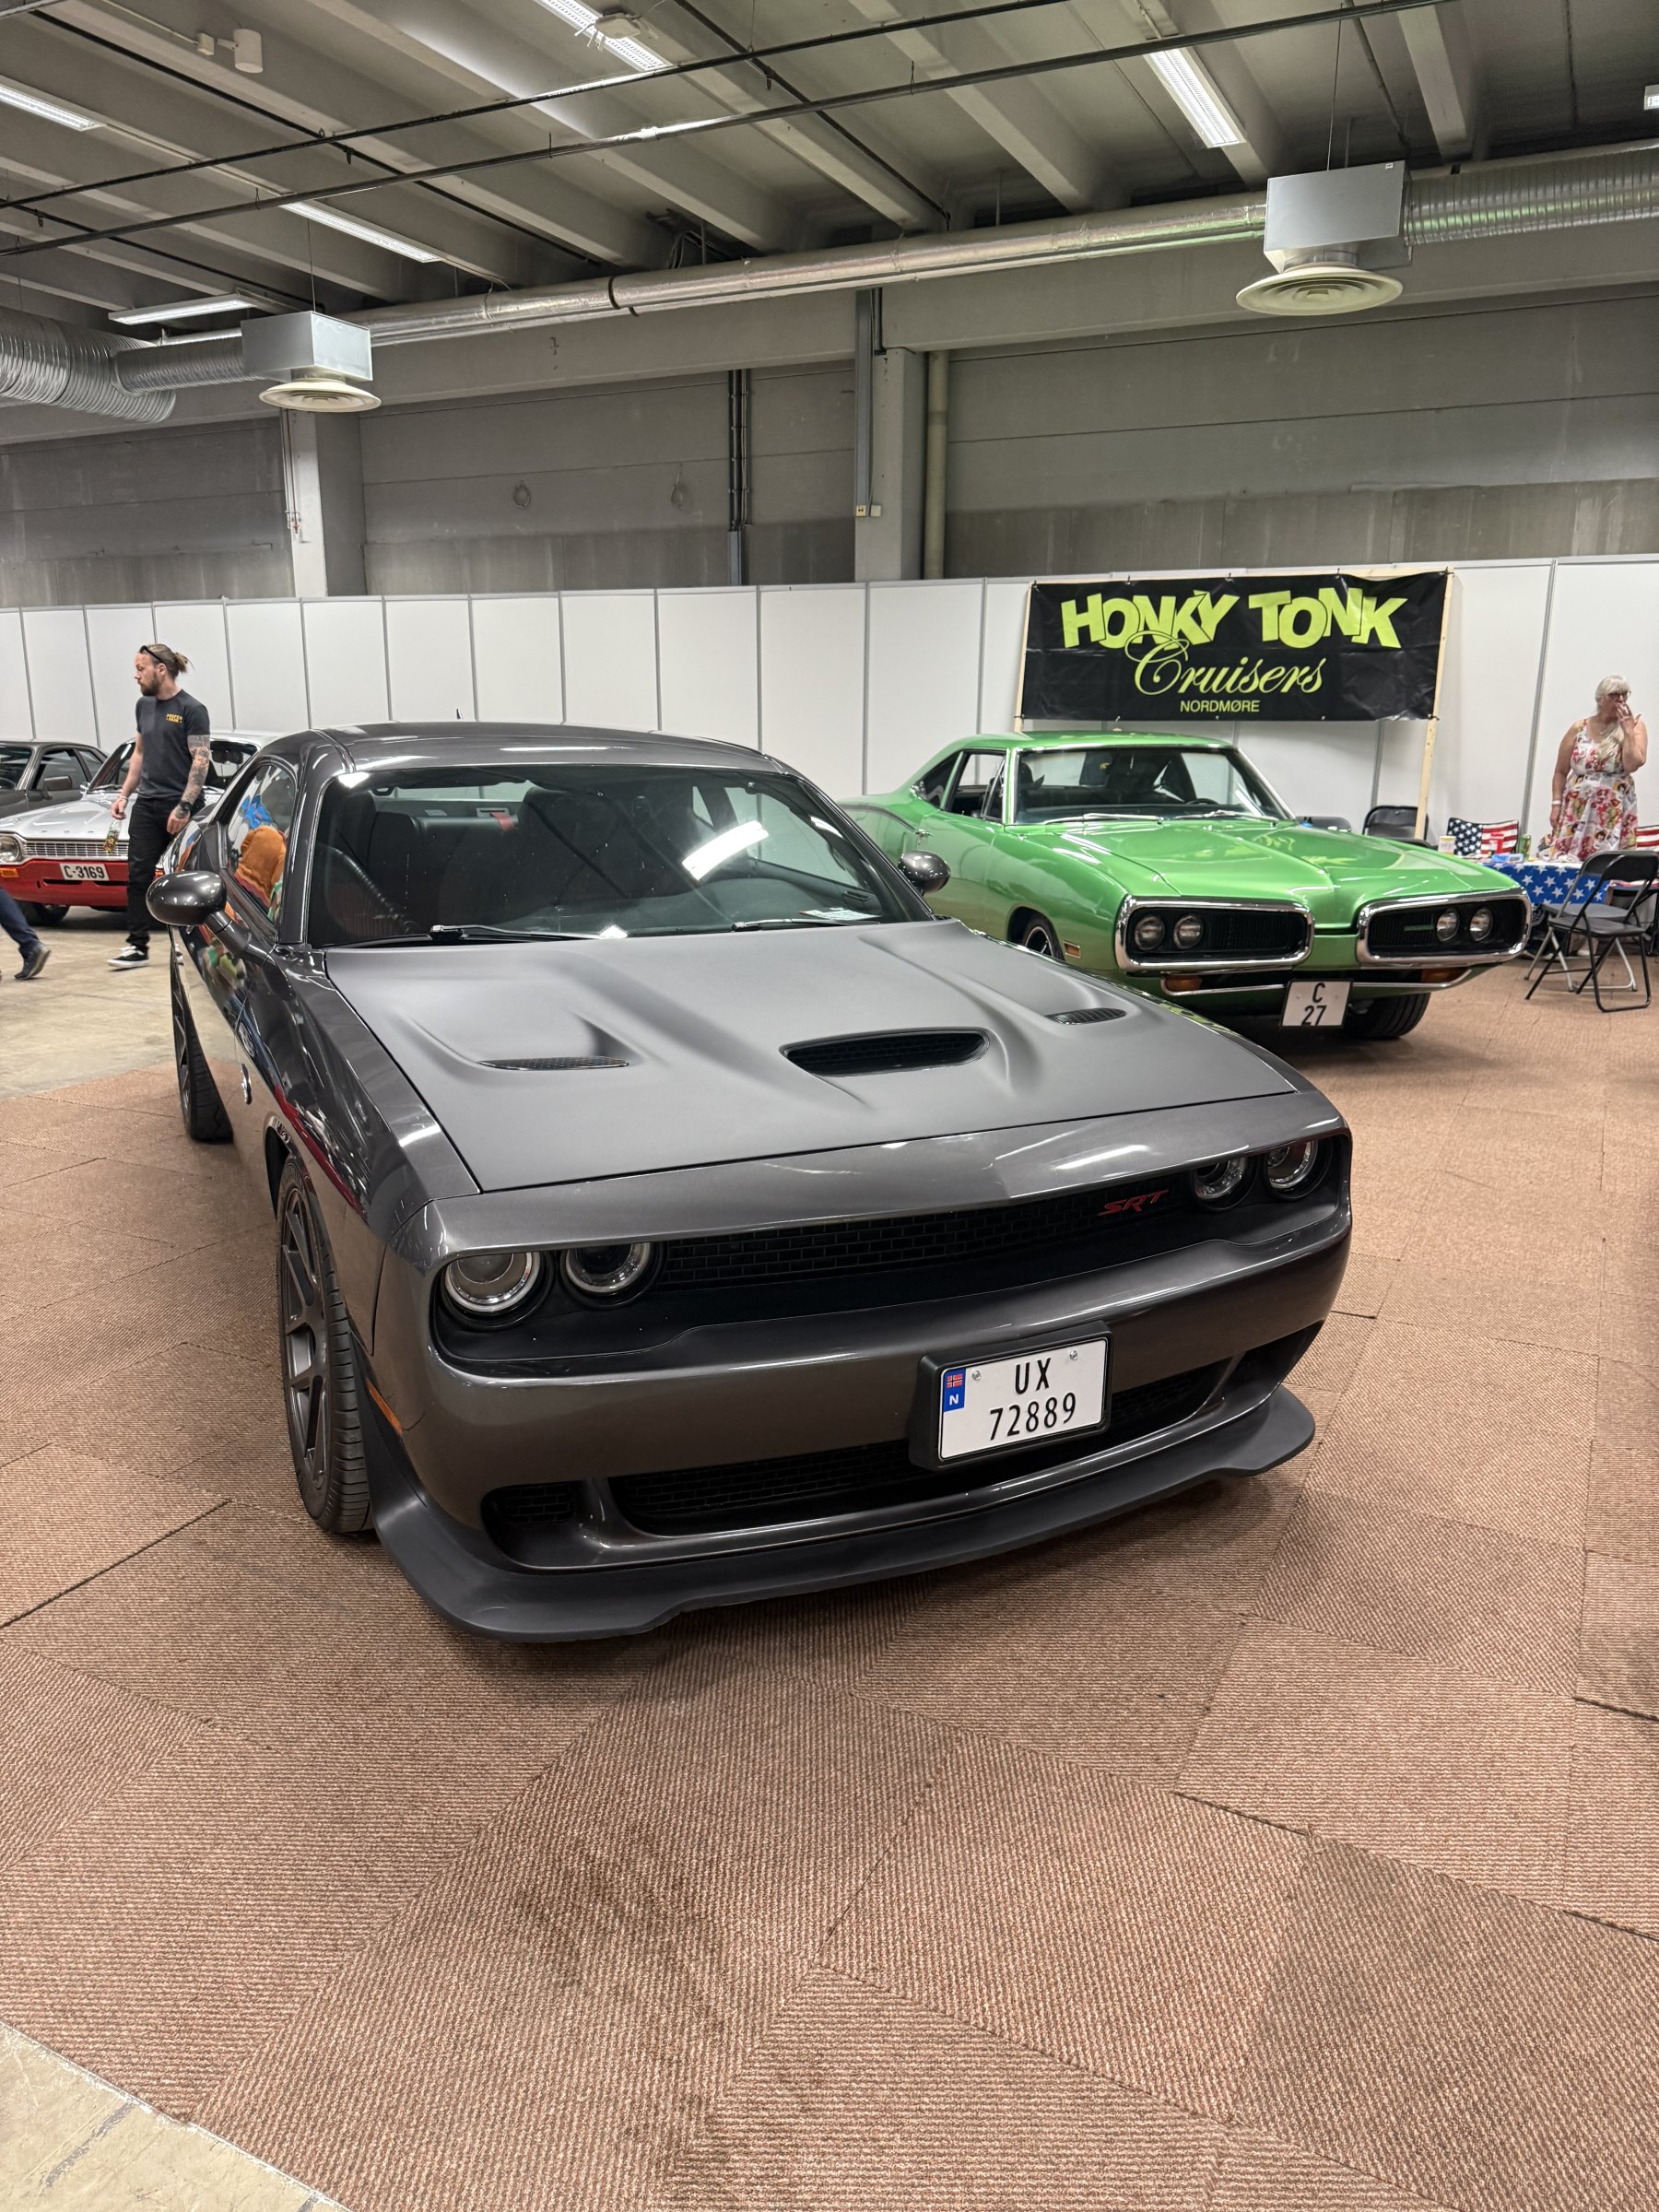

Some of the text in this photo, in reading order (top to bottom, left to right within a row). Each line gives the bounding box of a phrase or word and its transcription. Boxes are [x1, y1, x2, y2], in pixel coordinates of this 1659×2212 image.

[1061, 587, 1408, 649] HONKY TONK
[1124, 629, 1326, 695] Cruisers
[1180, 700, 1261, 712] NORDMØRE
[64, 865, 106, 878] C-3169
[1312, 982, 1326, 1004] C
[1301, 1005, 1328, 1026] 27
[1098, 1188, 1170, 1217] SRT
[1014, 1357, 1052, 1395] UX
[948, 1394, 959, 1406] N
[989, 1392, 1077, 1441] 72889
